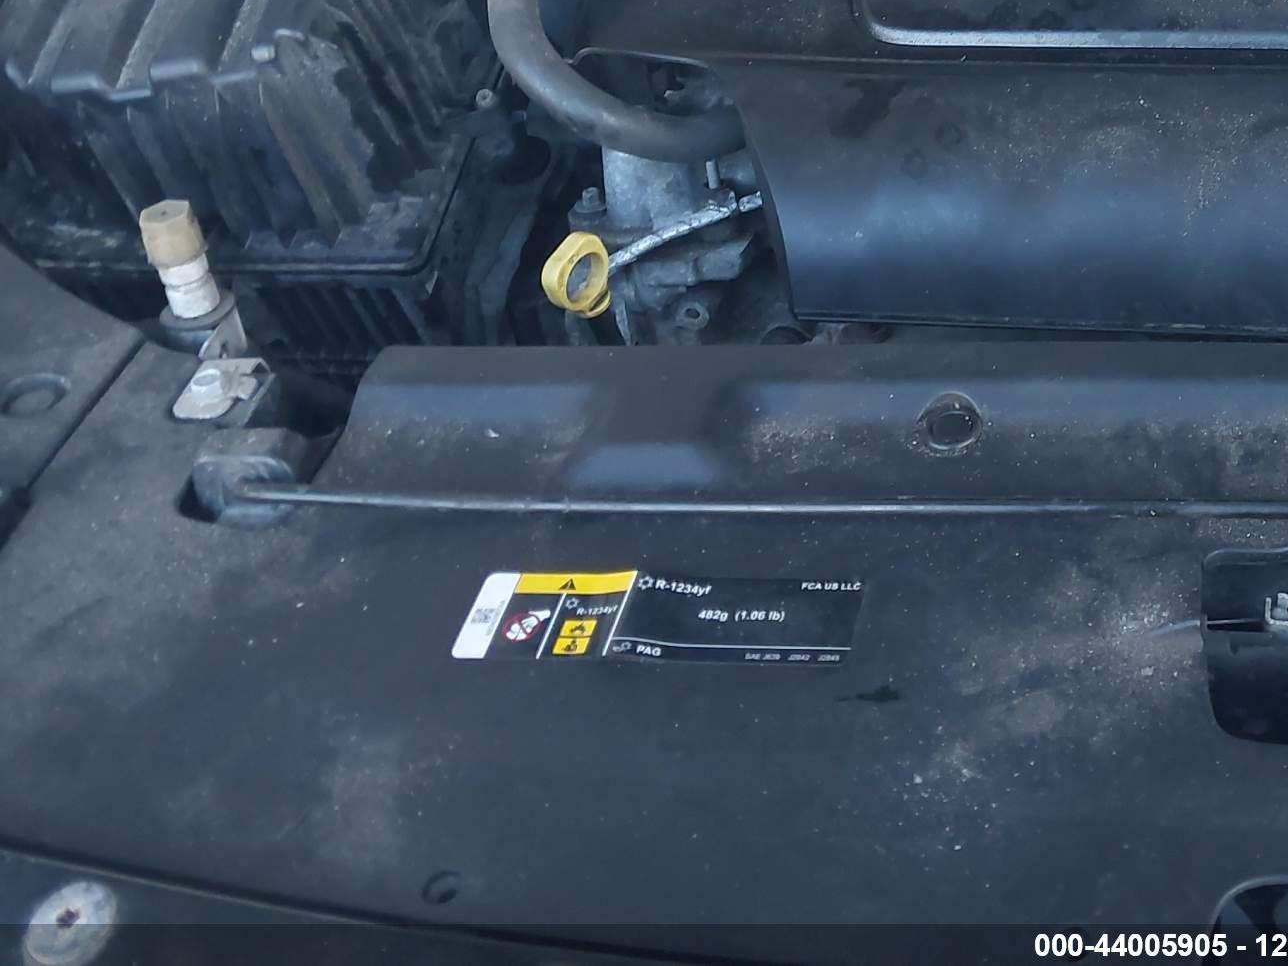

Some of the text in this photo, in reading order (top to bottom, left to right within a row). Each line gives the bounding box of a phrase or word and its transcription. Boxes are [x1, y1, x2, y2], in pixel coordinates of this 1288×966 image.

[655, 579, 712, 597] R-1234yf
[801, 582, 862, 591] FCA US LLC
[576, 605, 619, 616] R-1234yf
[698, 610, 728, 622] 482g
[768, 610, 785, 622] lb)
[636, 645, 662, 656] PAG
